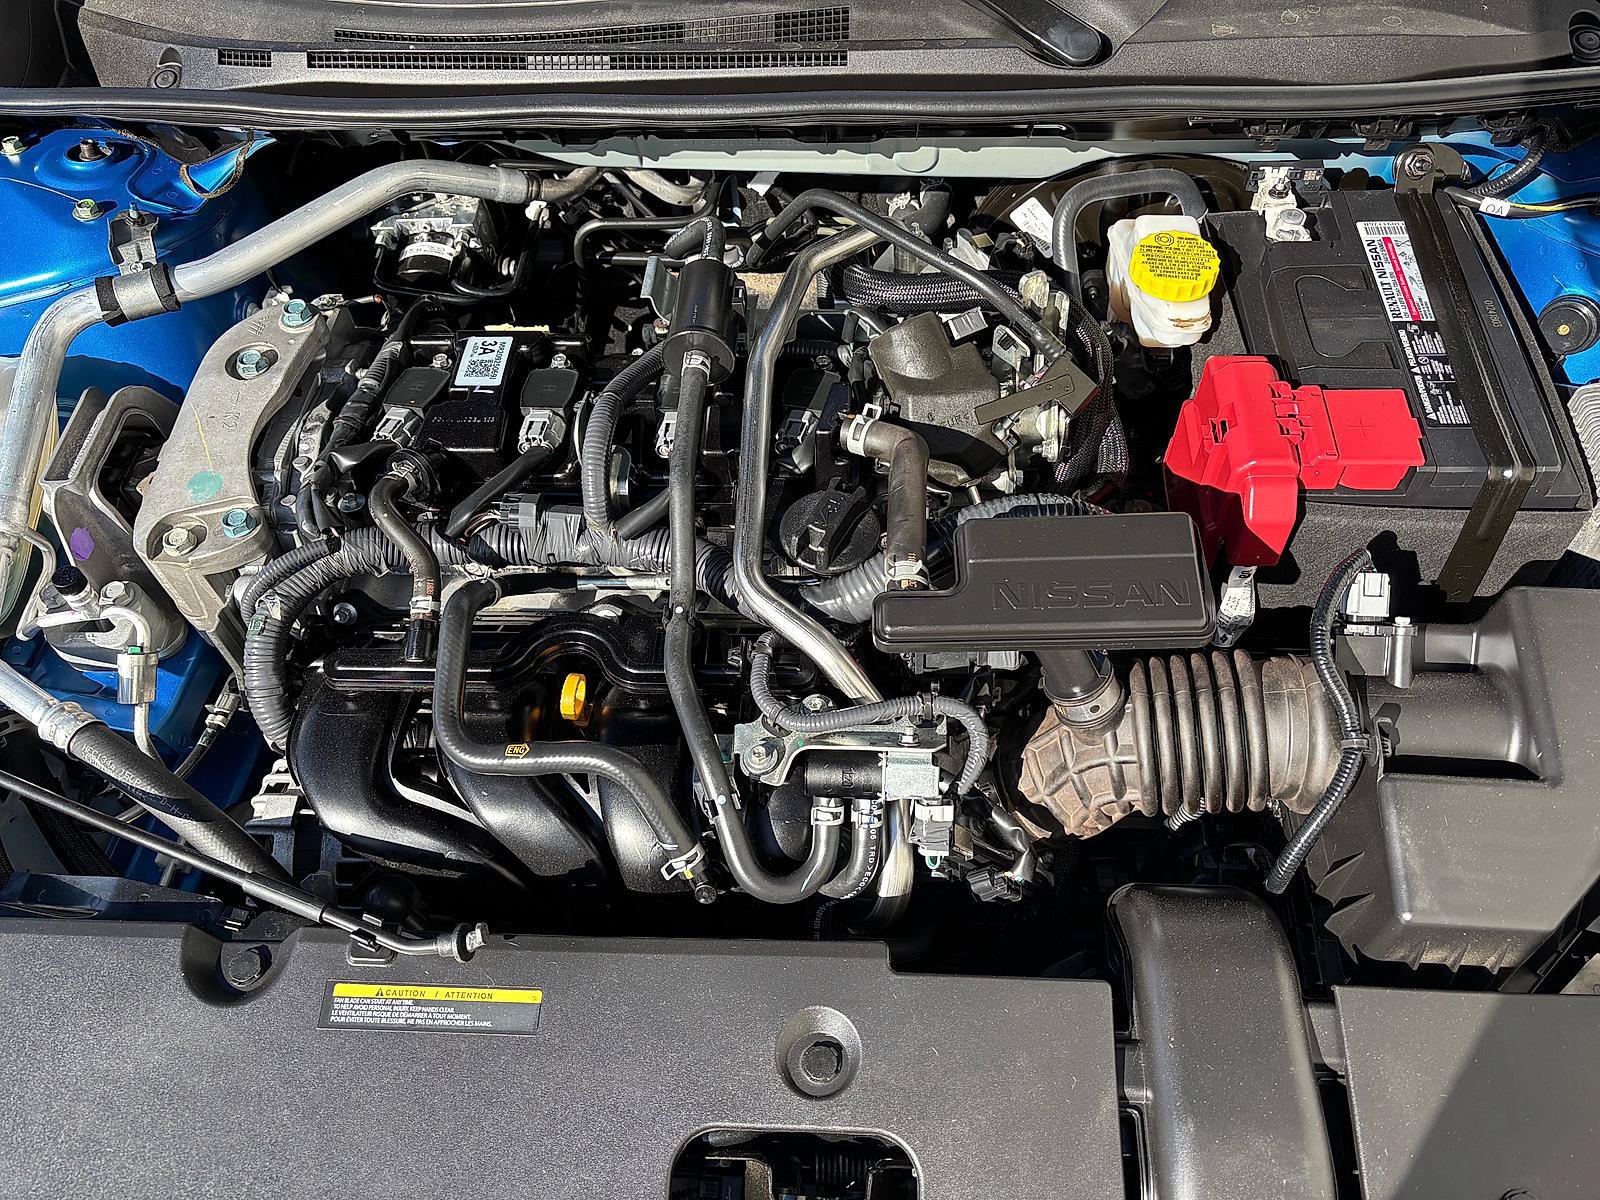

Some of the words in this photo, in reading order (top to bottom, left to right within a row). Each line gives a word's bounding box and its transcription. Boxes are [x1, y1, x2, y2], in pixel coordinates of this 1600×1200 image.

[1365, 239, 1388, 279] NISSAN
[1380, 281, 1403, 319] RENAULT
[993, 578, 1191, 610] NISSAN
[385, 989, 426, 997] CAUTION
[445, 991, 493, 999] ATTENTION
